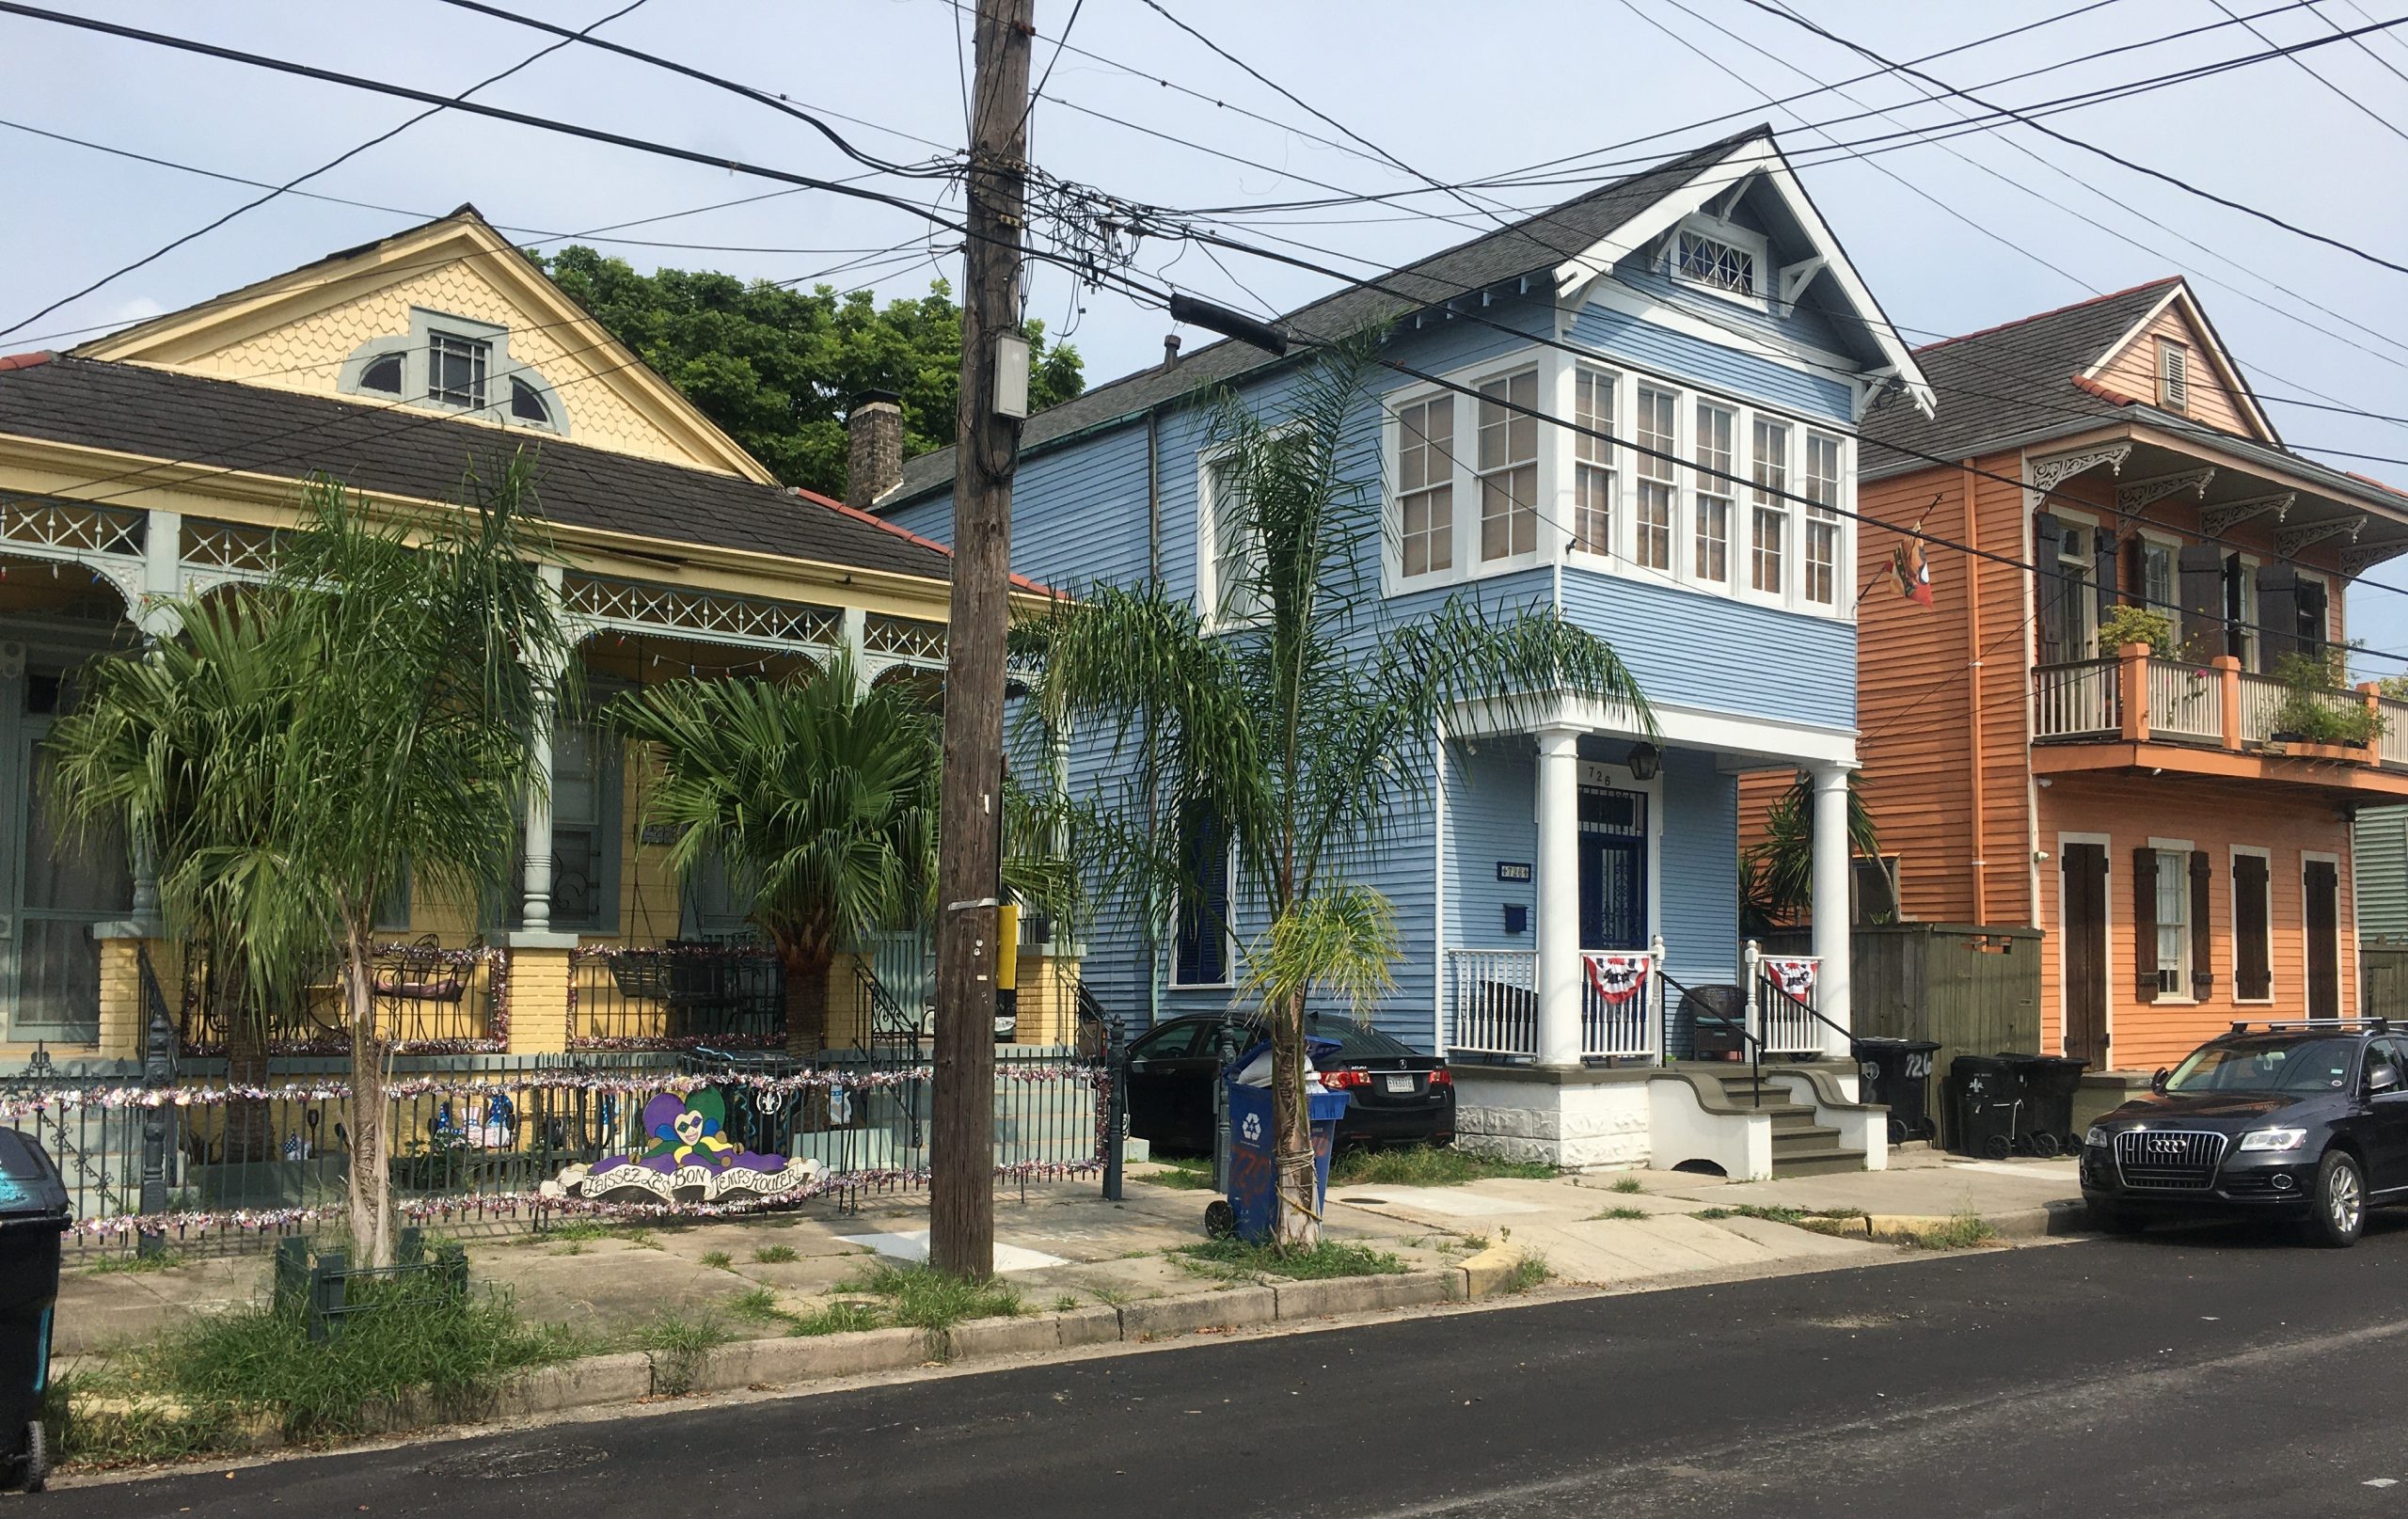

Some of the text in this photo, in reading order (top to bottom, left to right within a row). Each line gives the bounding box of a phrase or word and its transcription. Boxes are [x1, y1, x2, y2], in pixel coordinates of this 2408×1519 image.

[1589, 767, 1610, 786] 726
[1906, 1052, 1932, 1078] 726
[673, 1168, 705, 1189] BON
[712, 1169, 752, 1196] TEMPS
[752, 1166, 800, 1192] ROULER
